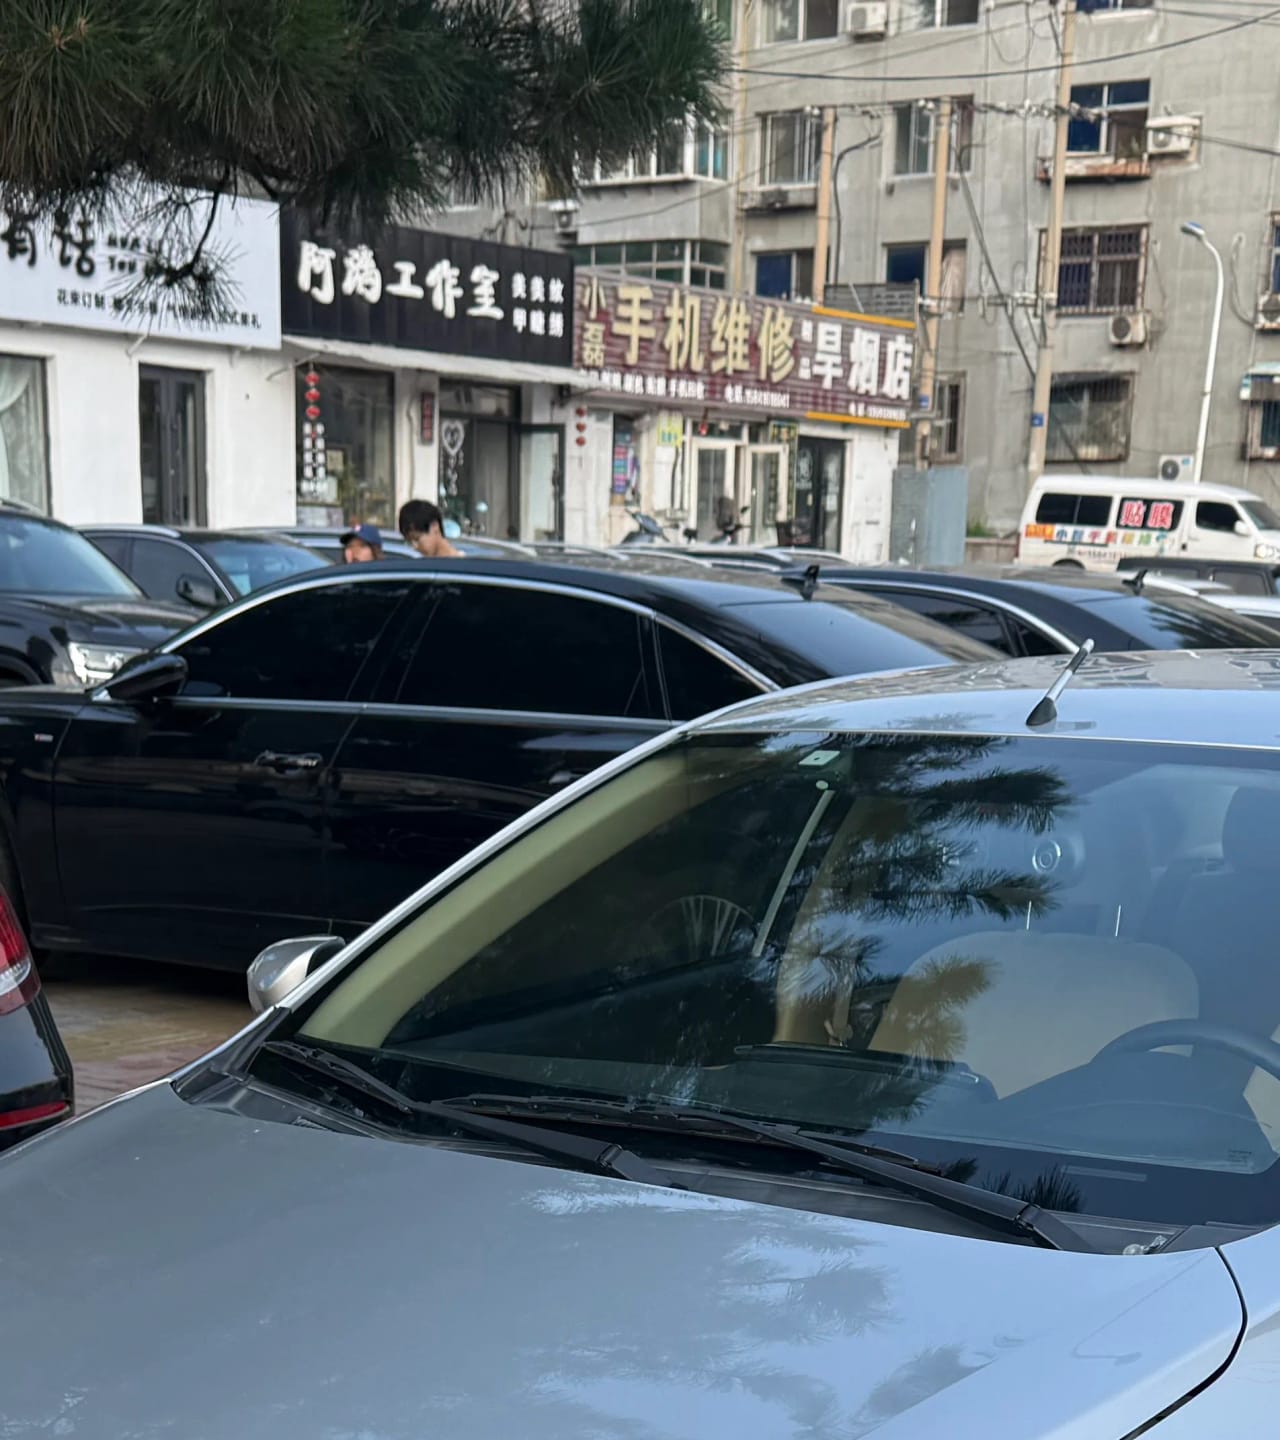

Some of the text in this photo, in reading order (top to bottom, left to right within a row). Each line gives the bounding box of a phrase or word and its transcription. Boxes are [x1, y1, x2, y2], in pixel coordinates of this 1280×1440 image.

[612, 285, 796, 384] 手机维修
[812, 322, 914, 400] 旱烟店
